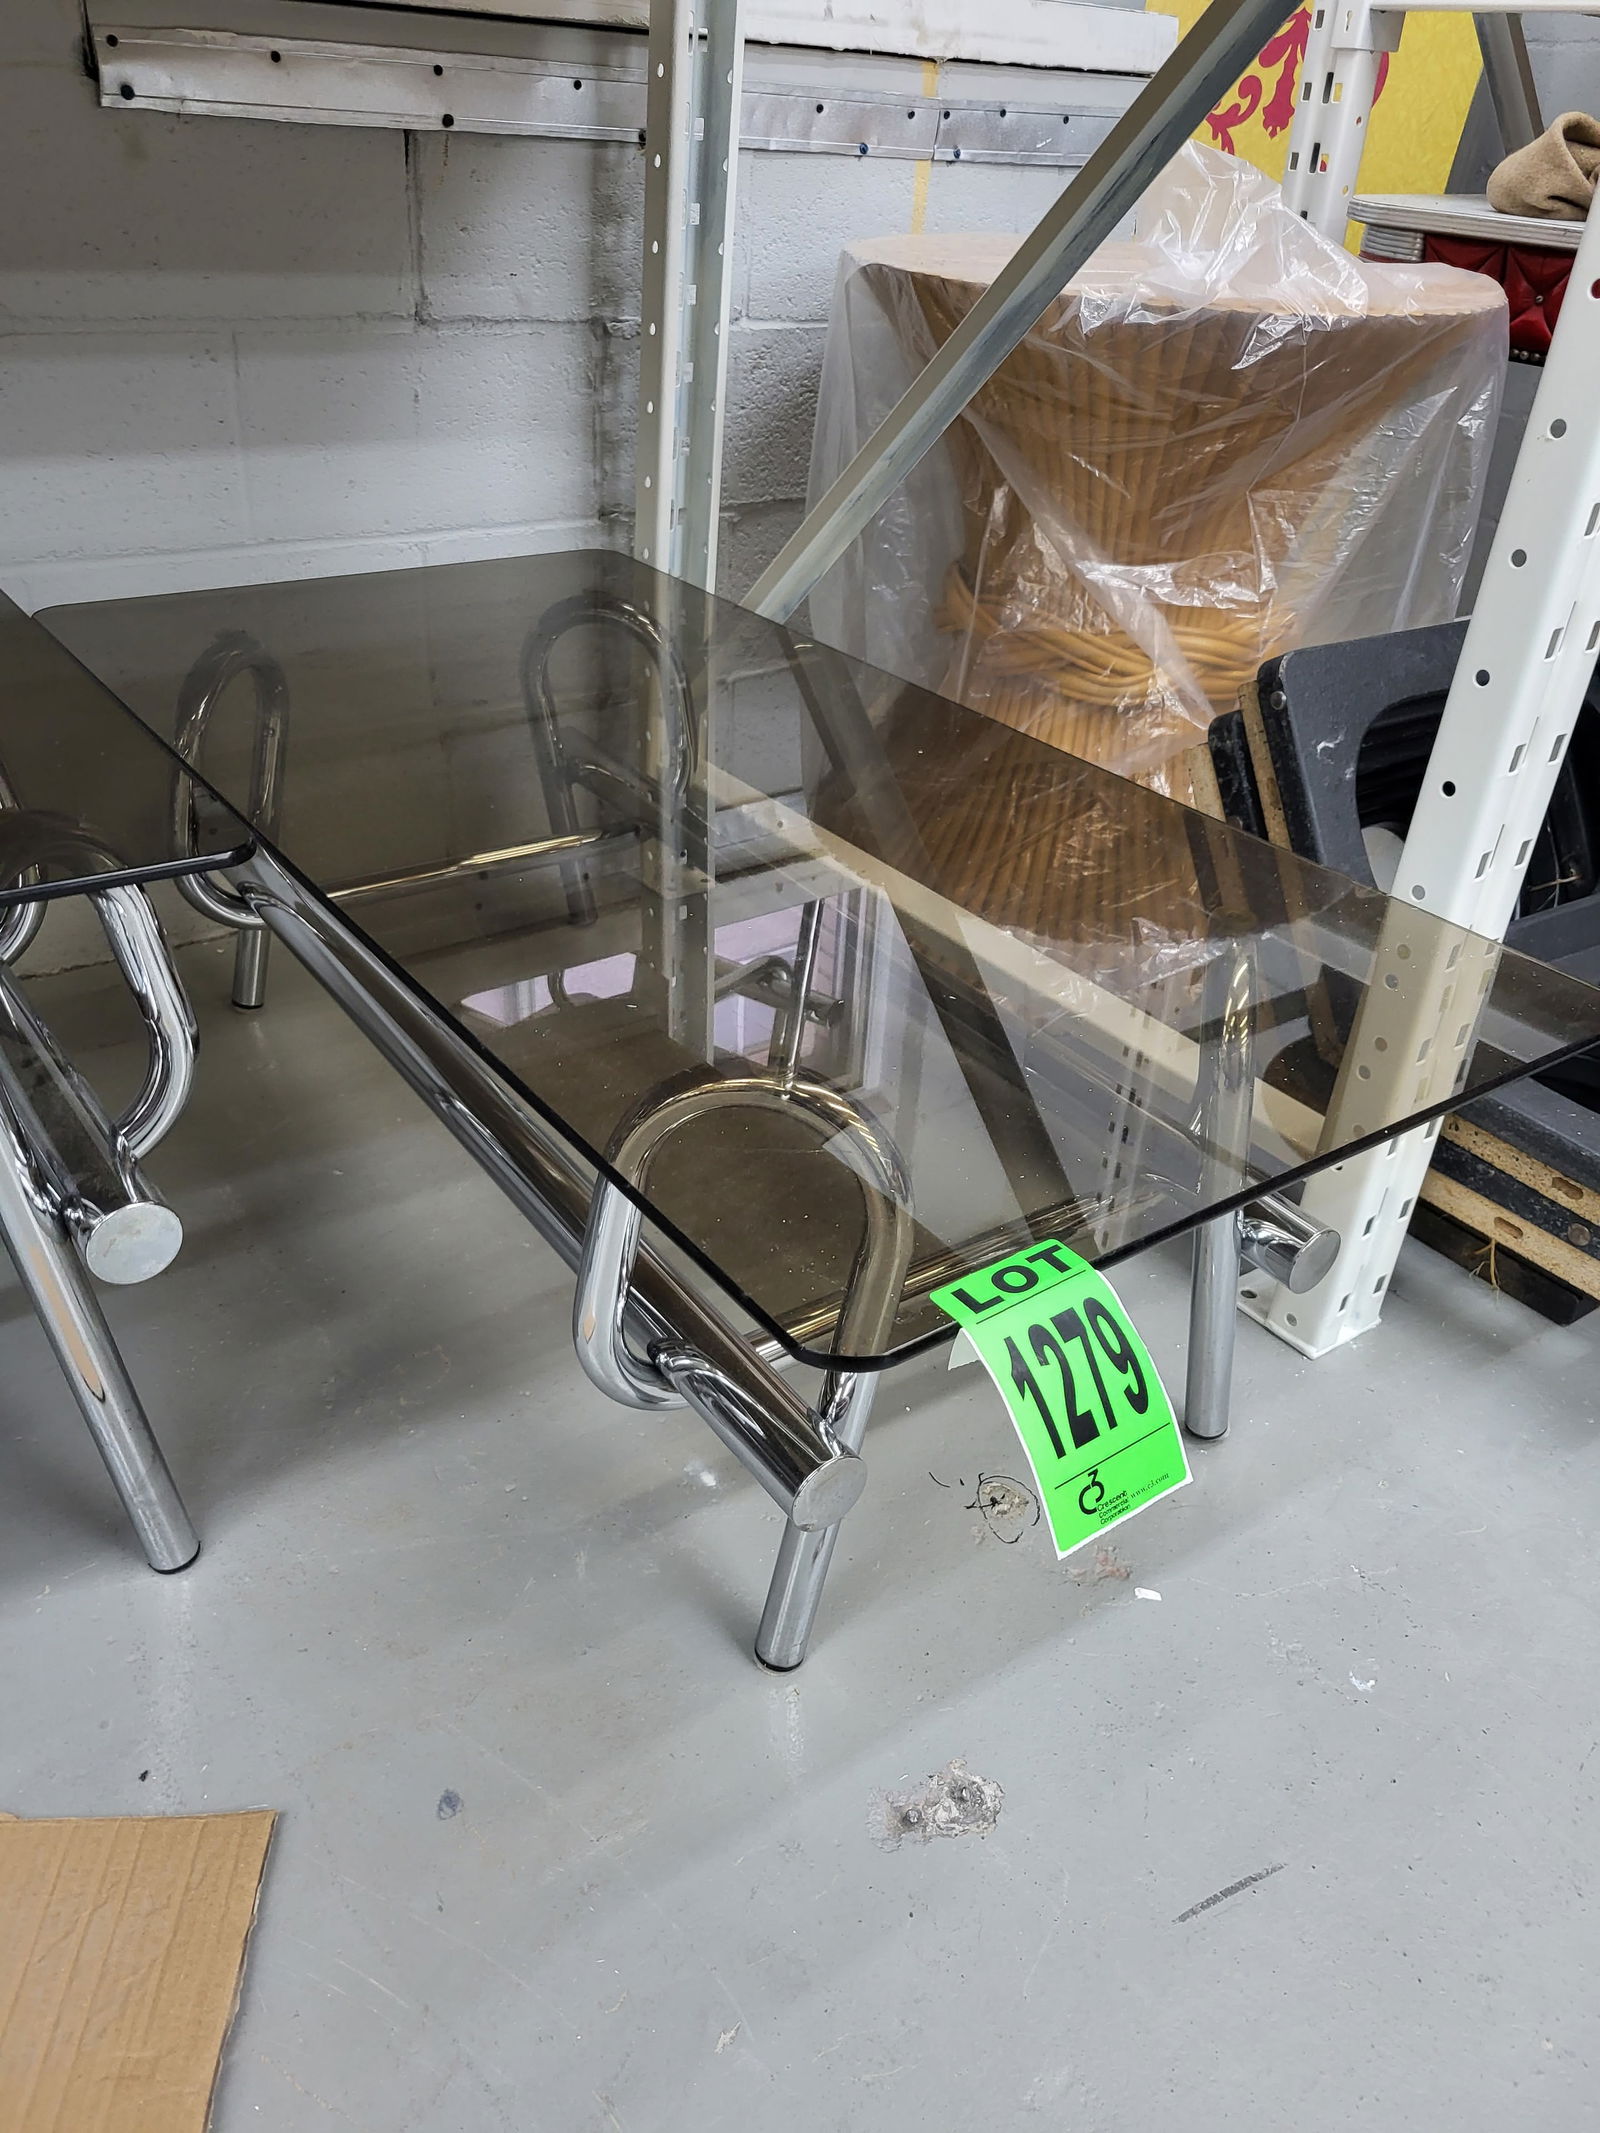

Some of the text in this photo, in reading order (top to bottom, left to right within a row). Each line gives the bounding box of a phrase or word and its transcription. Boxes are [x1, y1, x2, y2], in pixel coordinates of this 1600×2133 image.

[951, 1244, 1071, 1314] LOT
[1004, 1297, 1149, 1459] 1279
[1097, 1490, 1128, 1512] Crescent
